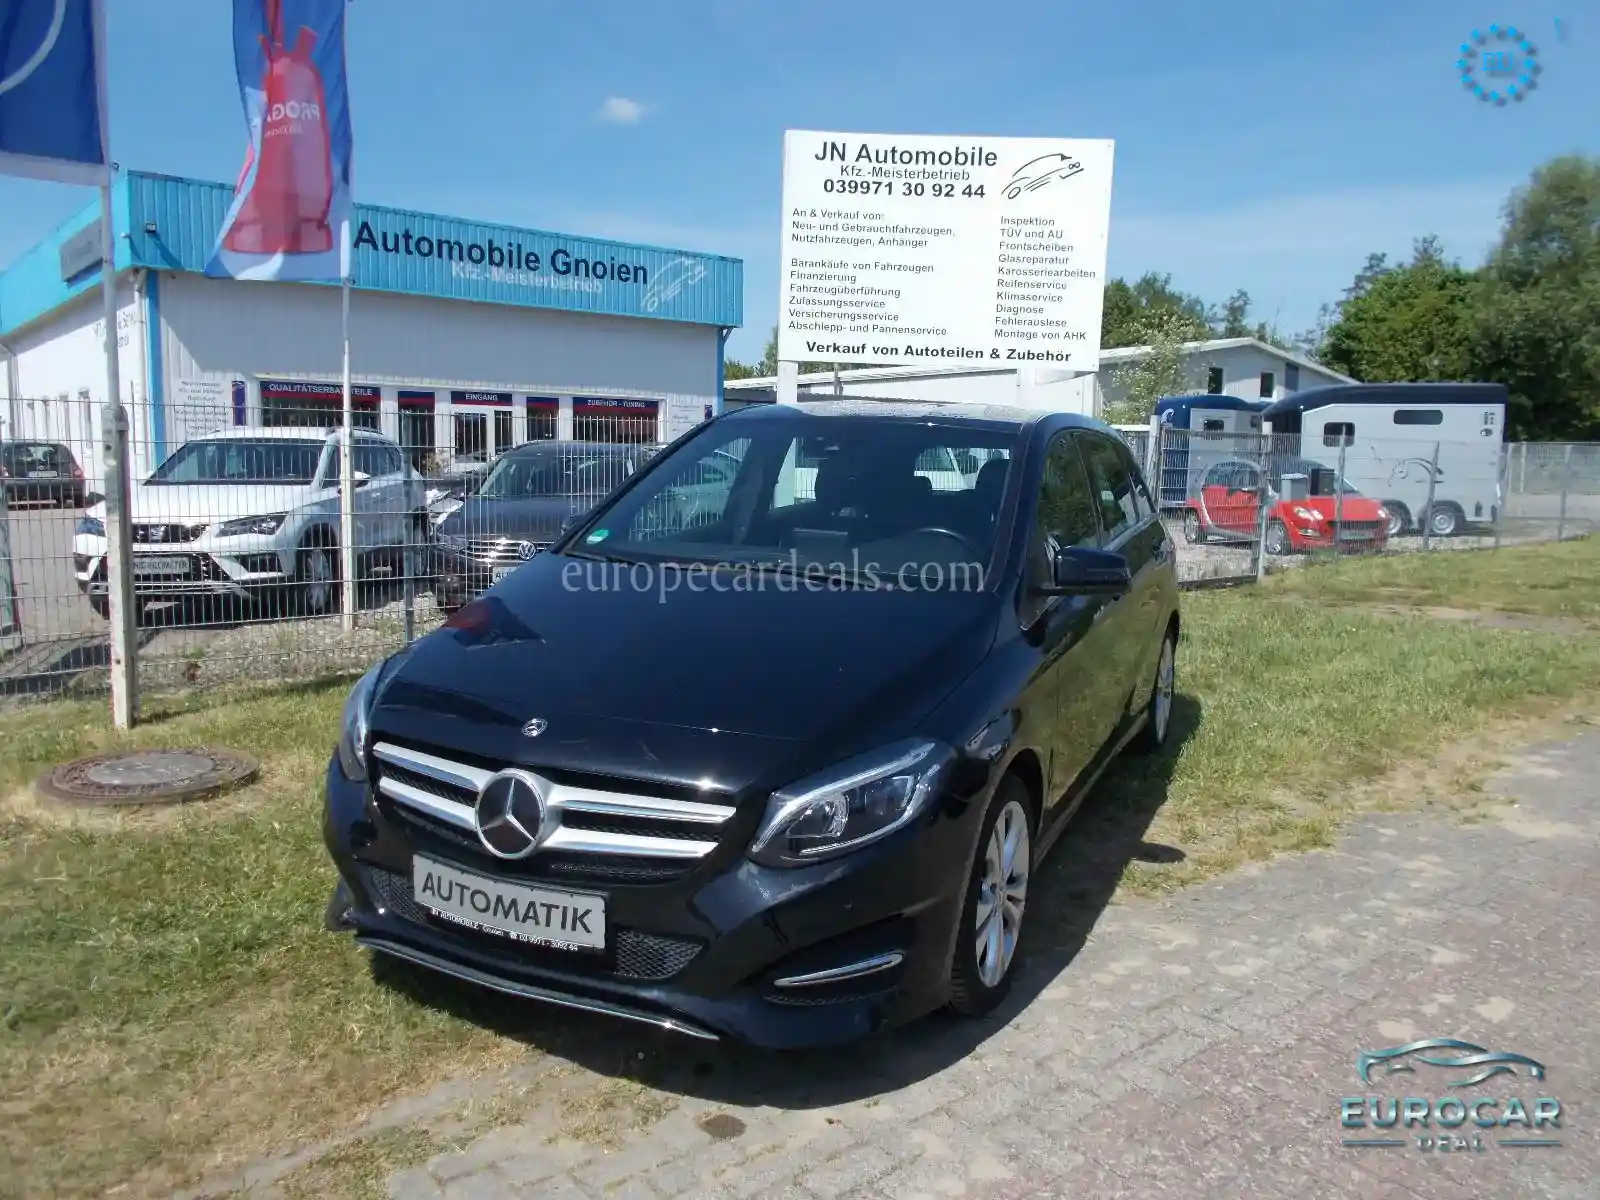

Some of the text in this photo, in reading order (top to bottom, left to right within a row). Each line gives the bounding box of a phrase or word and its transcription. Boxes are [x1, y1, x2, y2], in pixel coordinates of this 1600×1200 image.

[815, 141, 997, 167] JN Automobile
[840, 165, 970, 181] Kfz.-Meisterbetrieb
[823, 179, 986, 199] 039971 30 92 44
[792, 208, 807, 217] An
[809, 209, 817, 217] &
[820, 209, 860, 219] Verkauf
[1000, 216, 1055, 227] Inspektion
[792, 221, 956, 237] Neu- und Gebrauchtfahrzeugen,
[1000, 227, 1063, 239] TÜV und AU
[791, 233, 929, 248] Nutzfahrzeugen, Anhänger
[999, 241, 1074, 252] Frontscheiben
[353, 221, 649, 285] Automobile Gnoien
[791, 258, 934, 273] Barankäufe von Fahrzeugen
[998, 254, 1070, 265] Glasreparatur
[790, 271, 857, 284] Finanzierung
[997, 266, 1096, 278] Karosseriearbeiten
[789, 283, 901, 298] Fahrzeugüberführung
[997, 279, 1067, 290] Reifenservice
[788, 296, 885, 308] Zulassungsservice
[996, 291, 1063, 302] Klimaservice
[788, 308, 899, 321] Versicherungsservice
[996, 303, 1044, 315] Diagnose
[995, 316, 1067, 327] Fehlerauslese
[788, 321, 947, 336] Abschlepp- und Pannenservice
[994, 329, 1087, 340] Montage von AHK
[806, 341, 1072, 362] Verkauf von Autoteilen & Zubehör
[465, 393, 498, 402] EINGANG
[421, 871, 593, 934] AUTOMATIK
